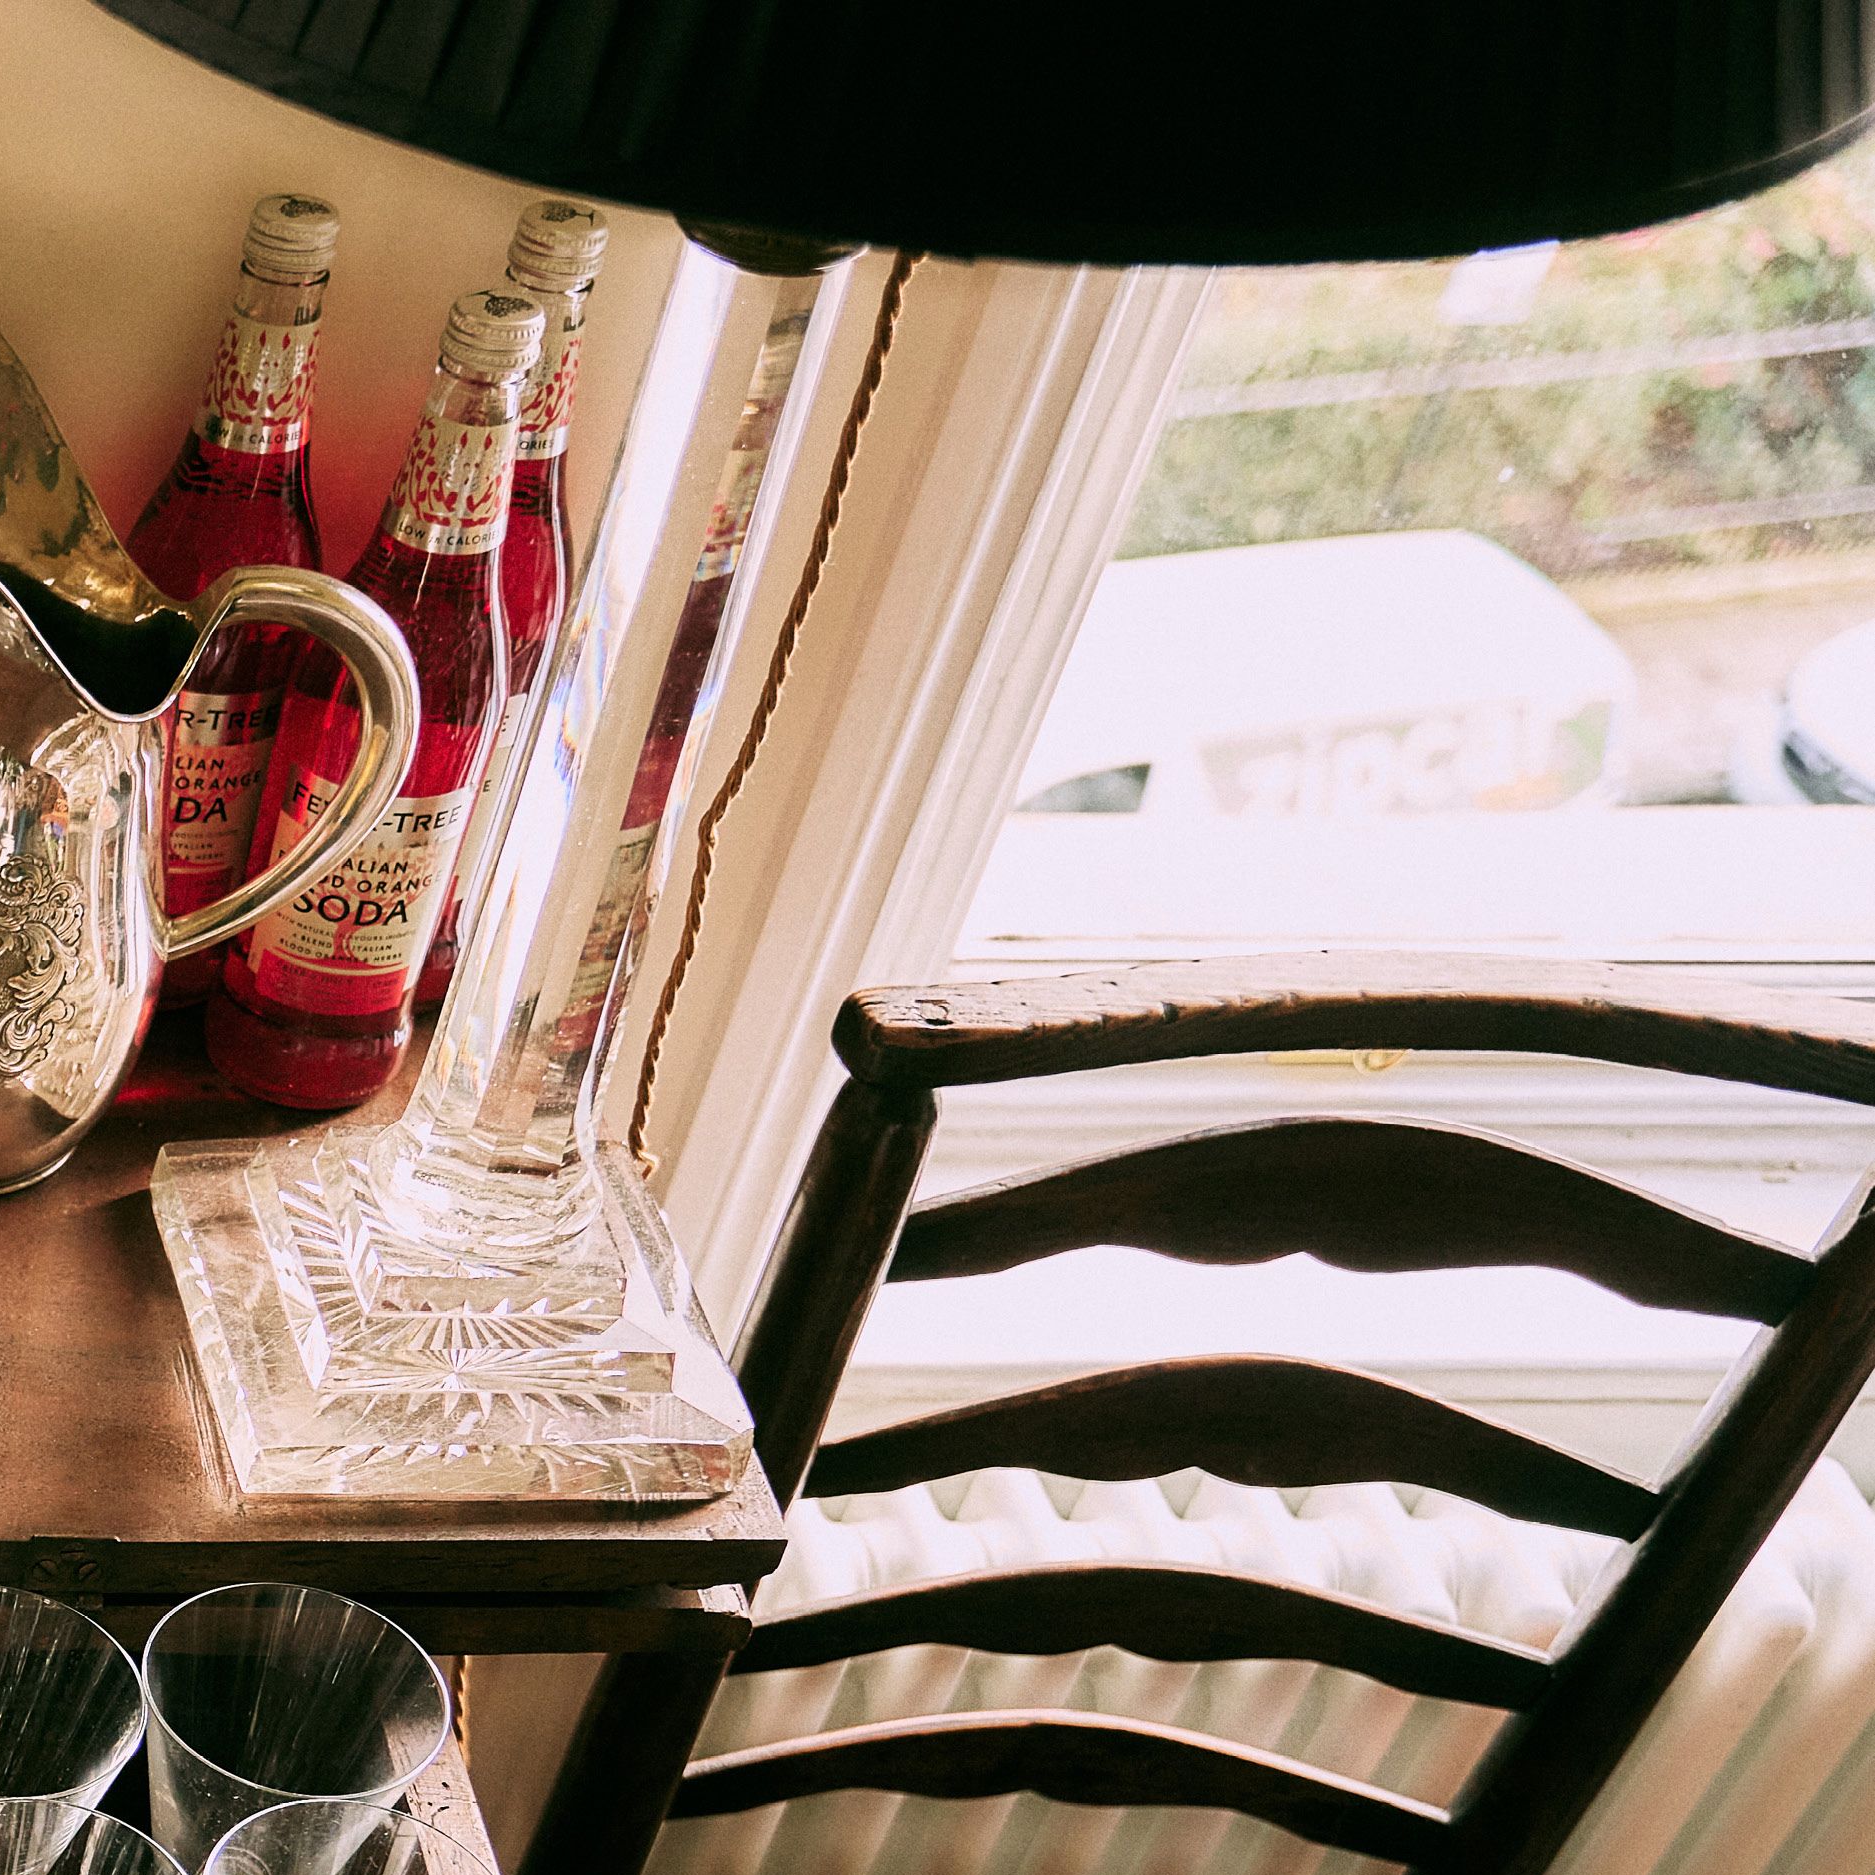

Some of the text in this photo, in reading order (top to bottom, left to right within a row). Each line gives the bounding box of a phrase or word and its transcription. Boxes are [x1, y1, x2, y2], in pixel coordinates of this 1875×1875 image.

[250, 430, 303, 444] CALORIES
[519, 439, 555, 451] ORIES
[399, 522, 426, 540] LOW
[178, 703, 279, 731] R-TREE
[175, 756, 225, 771] LIAN
[174, 770, 262, 791] ORANGE
[173, 796, 228, 824] DA
[344, 856, 409, 875] ALIAN
[356, 870, 442, 895] ORANGE
[292, 894, 409, 927] SODA
[296, 921, 335, 938] NATURAL
[278, 937, 313, 955] BLOOD
[373, 952, 403, 962] HERBS
[300, 934, 333, 950] BLEND
[351, 944, 393, 952] ITALIAN
